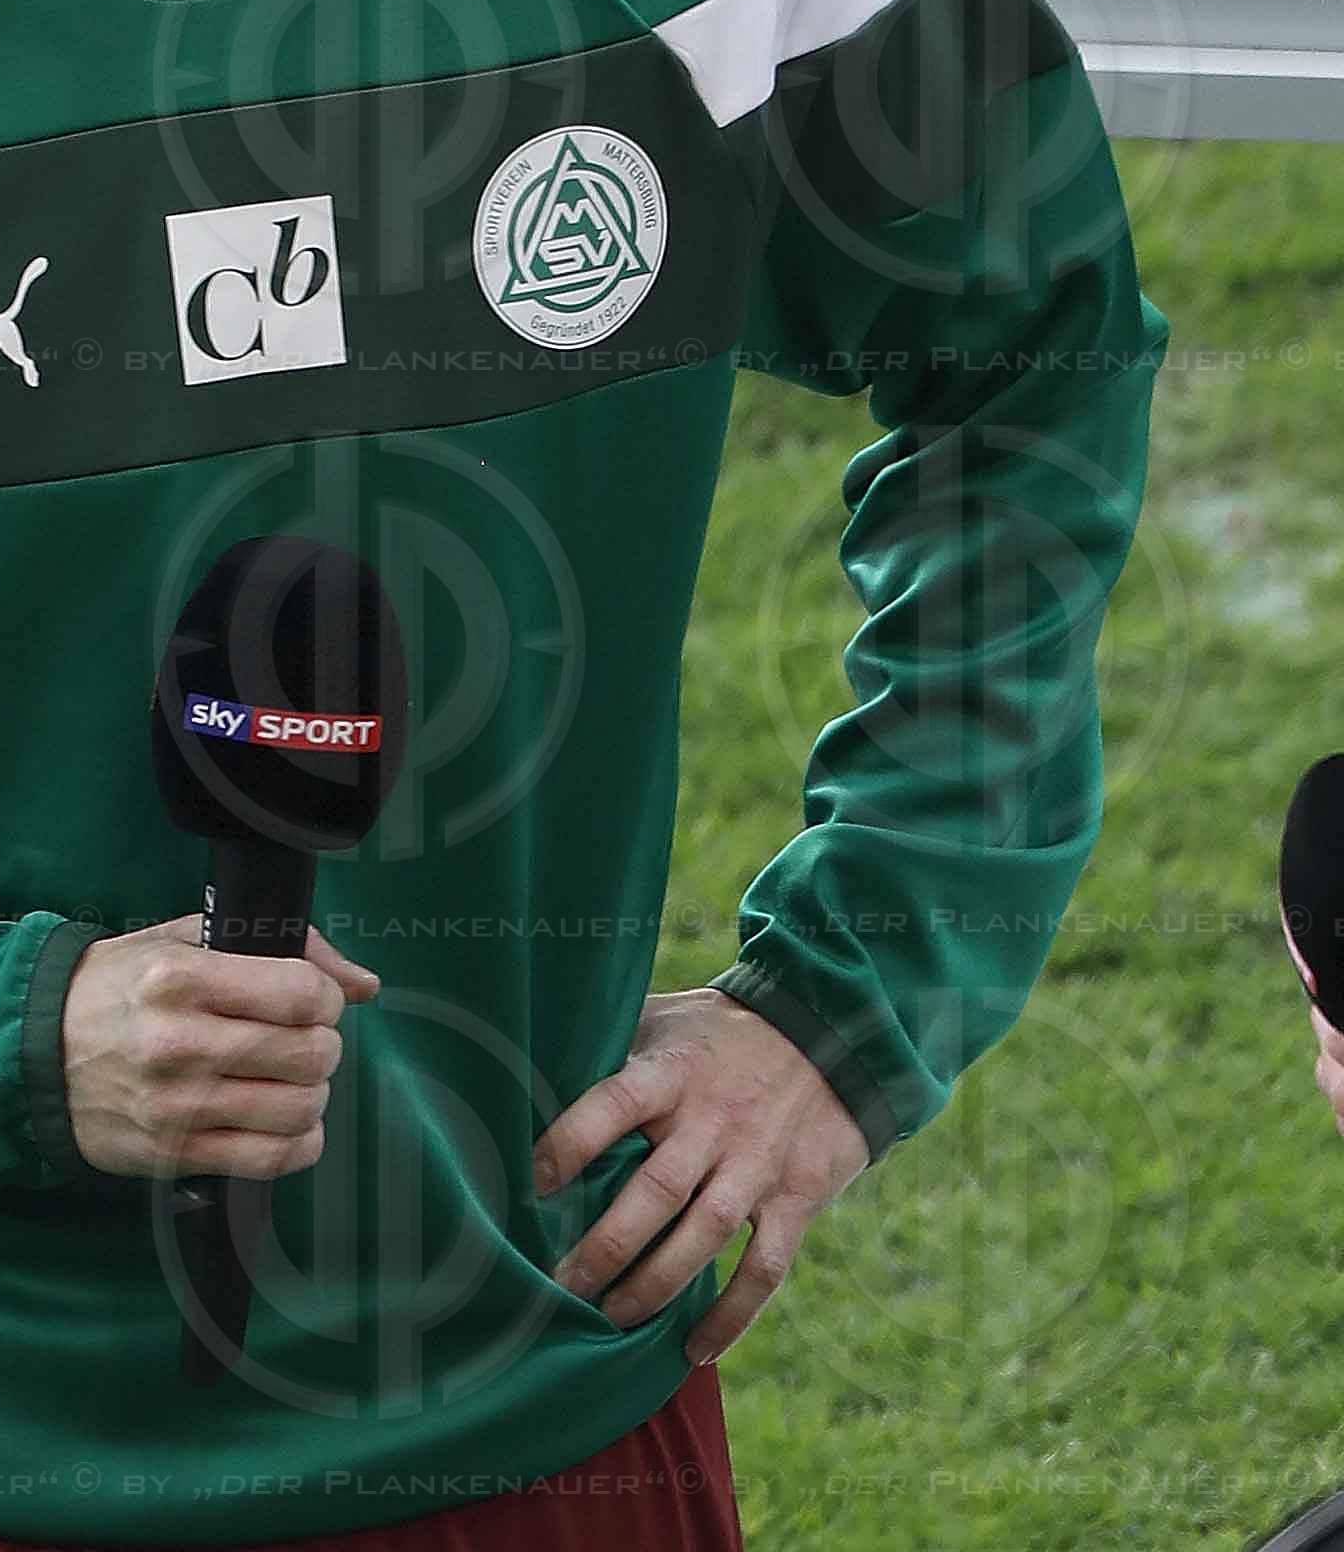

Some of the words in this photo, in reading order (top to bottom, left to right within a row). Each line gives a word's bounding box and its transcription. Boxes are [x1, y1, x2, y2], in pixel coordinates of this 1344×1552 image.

[485, 159, 534, 257] SPORTVEREIN
[602, 142, 658, 231] MATTERSBURG
[530, 313, 594, 338] Gegründet
[598, 296, 628, 327] 1922
[191, 701, 246, 736] sky
[256, 715, 377, 745] SPORT
